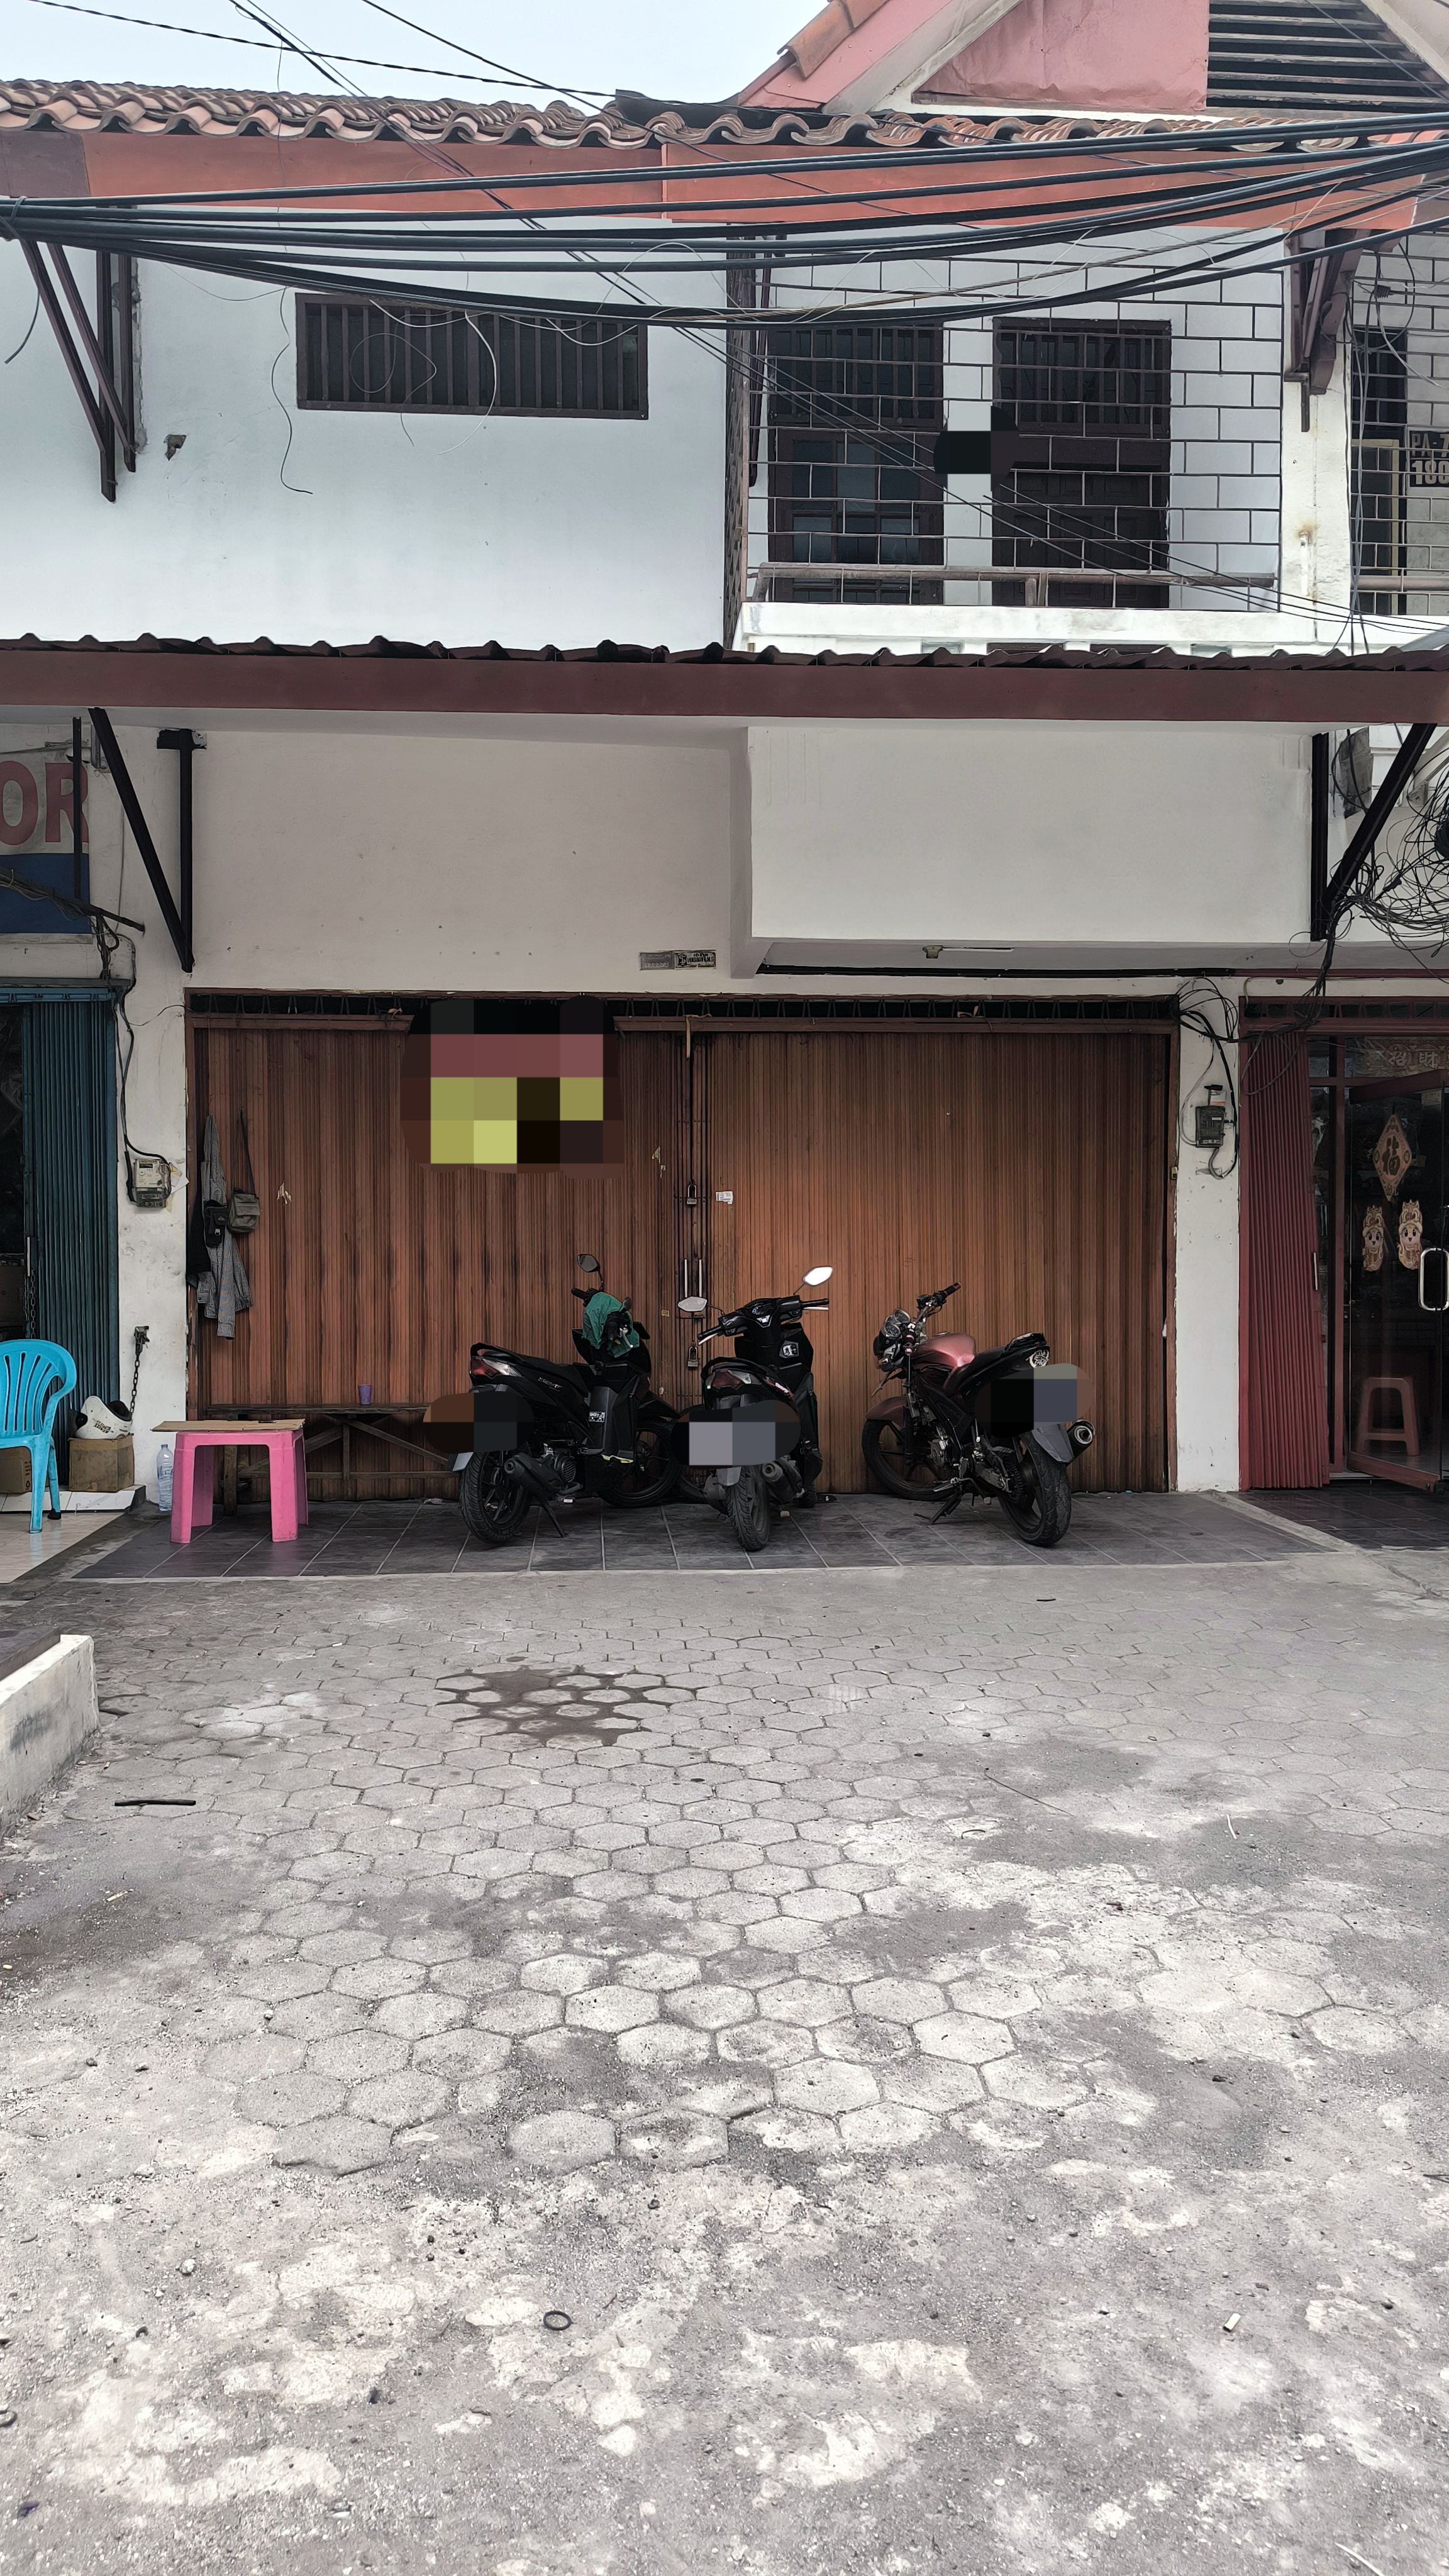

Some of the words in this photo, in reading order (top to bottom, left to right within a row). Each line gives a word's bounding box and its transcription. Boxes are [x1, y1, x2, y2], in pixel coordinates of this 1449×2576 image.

[0, 760, 89, 845] OR
[1387, 1052, 1449, 1068] 招財
[1382, 1135, 1401, 1176] 福
